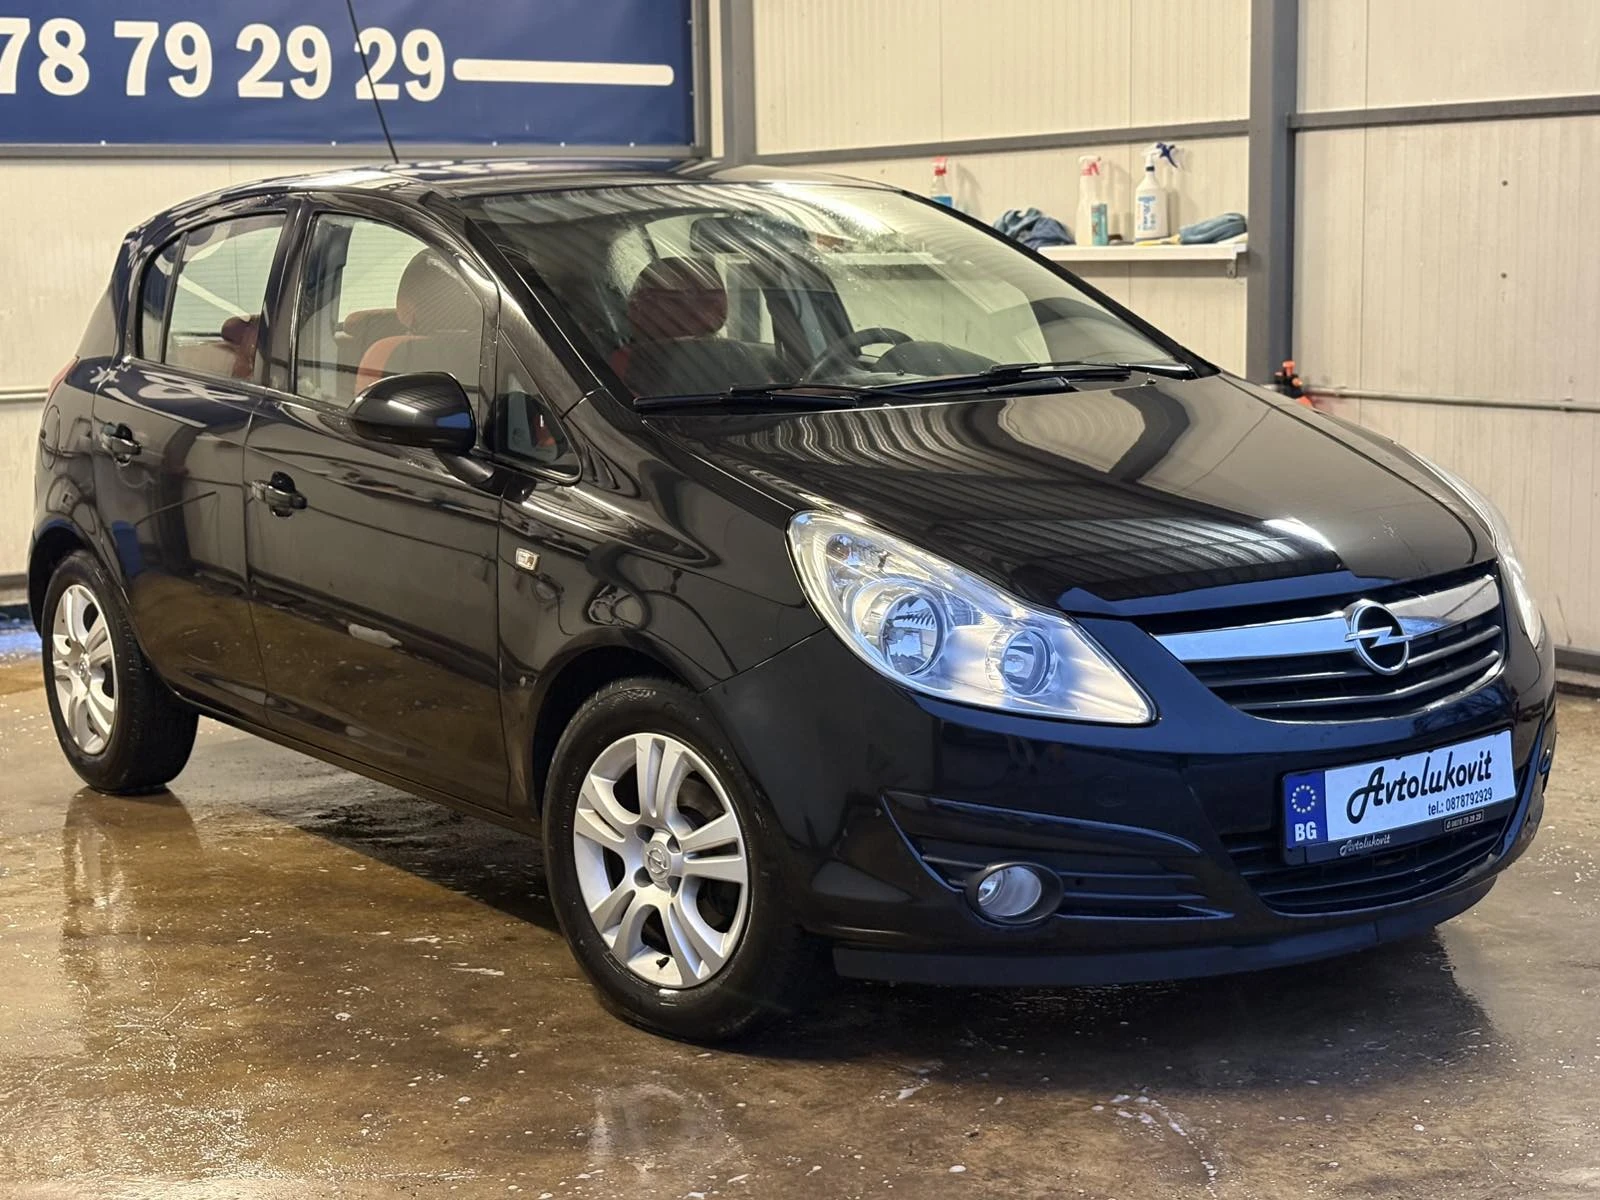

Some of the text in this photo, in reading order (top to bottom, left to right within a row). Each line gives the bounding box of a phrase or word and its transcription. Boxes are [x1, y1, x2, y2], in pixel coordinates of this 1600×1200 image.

[114, 20, 212, 98] 79
[236, 24, 332, 99] 29
[354, 28, 445, 102] 29
[1346, 749, 1492, 825] Avtolukovit
[1445, 786, 1493, 811] 0878792929
[1294, 822, 1317, 842] BG
[1339, 833, 1391, 857] Avtolukovit
